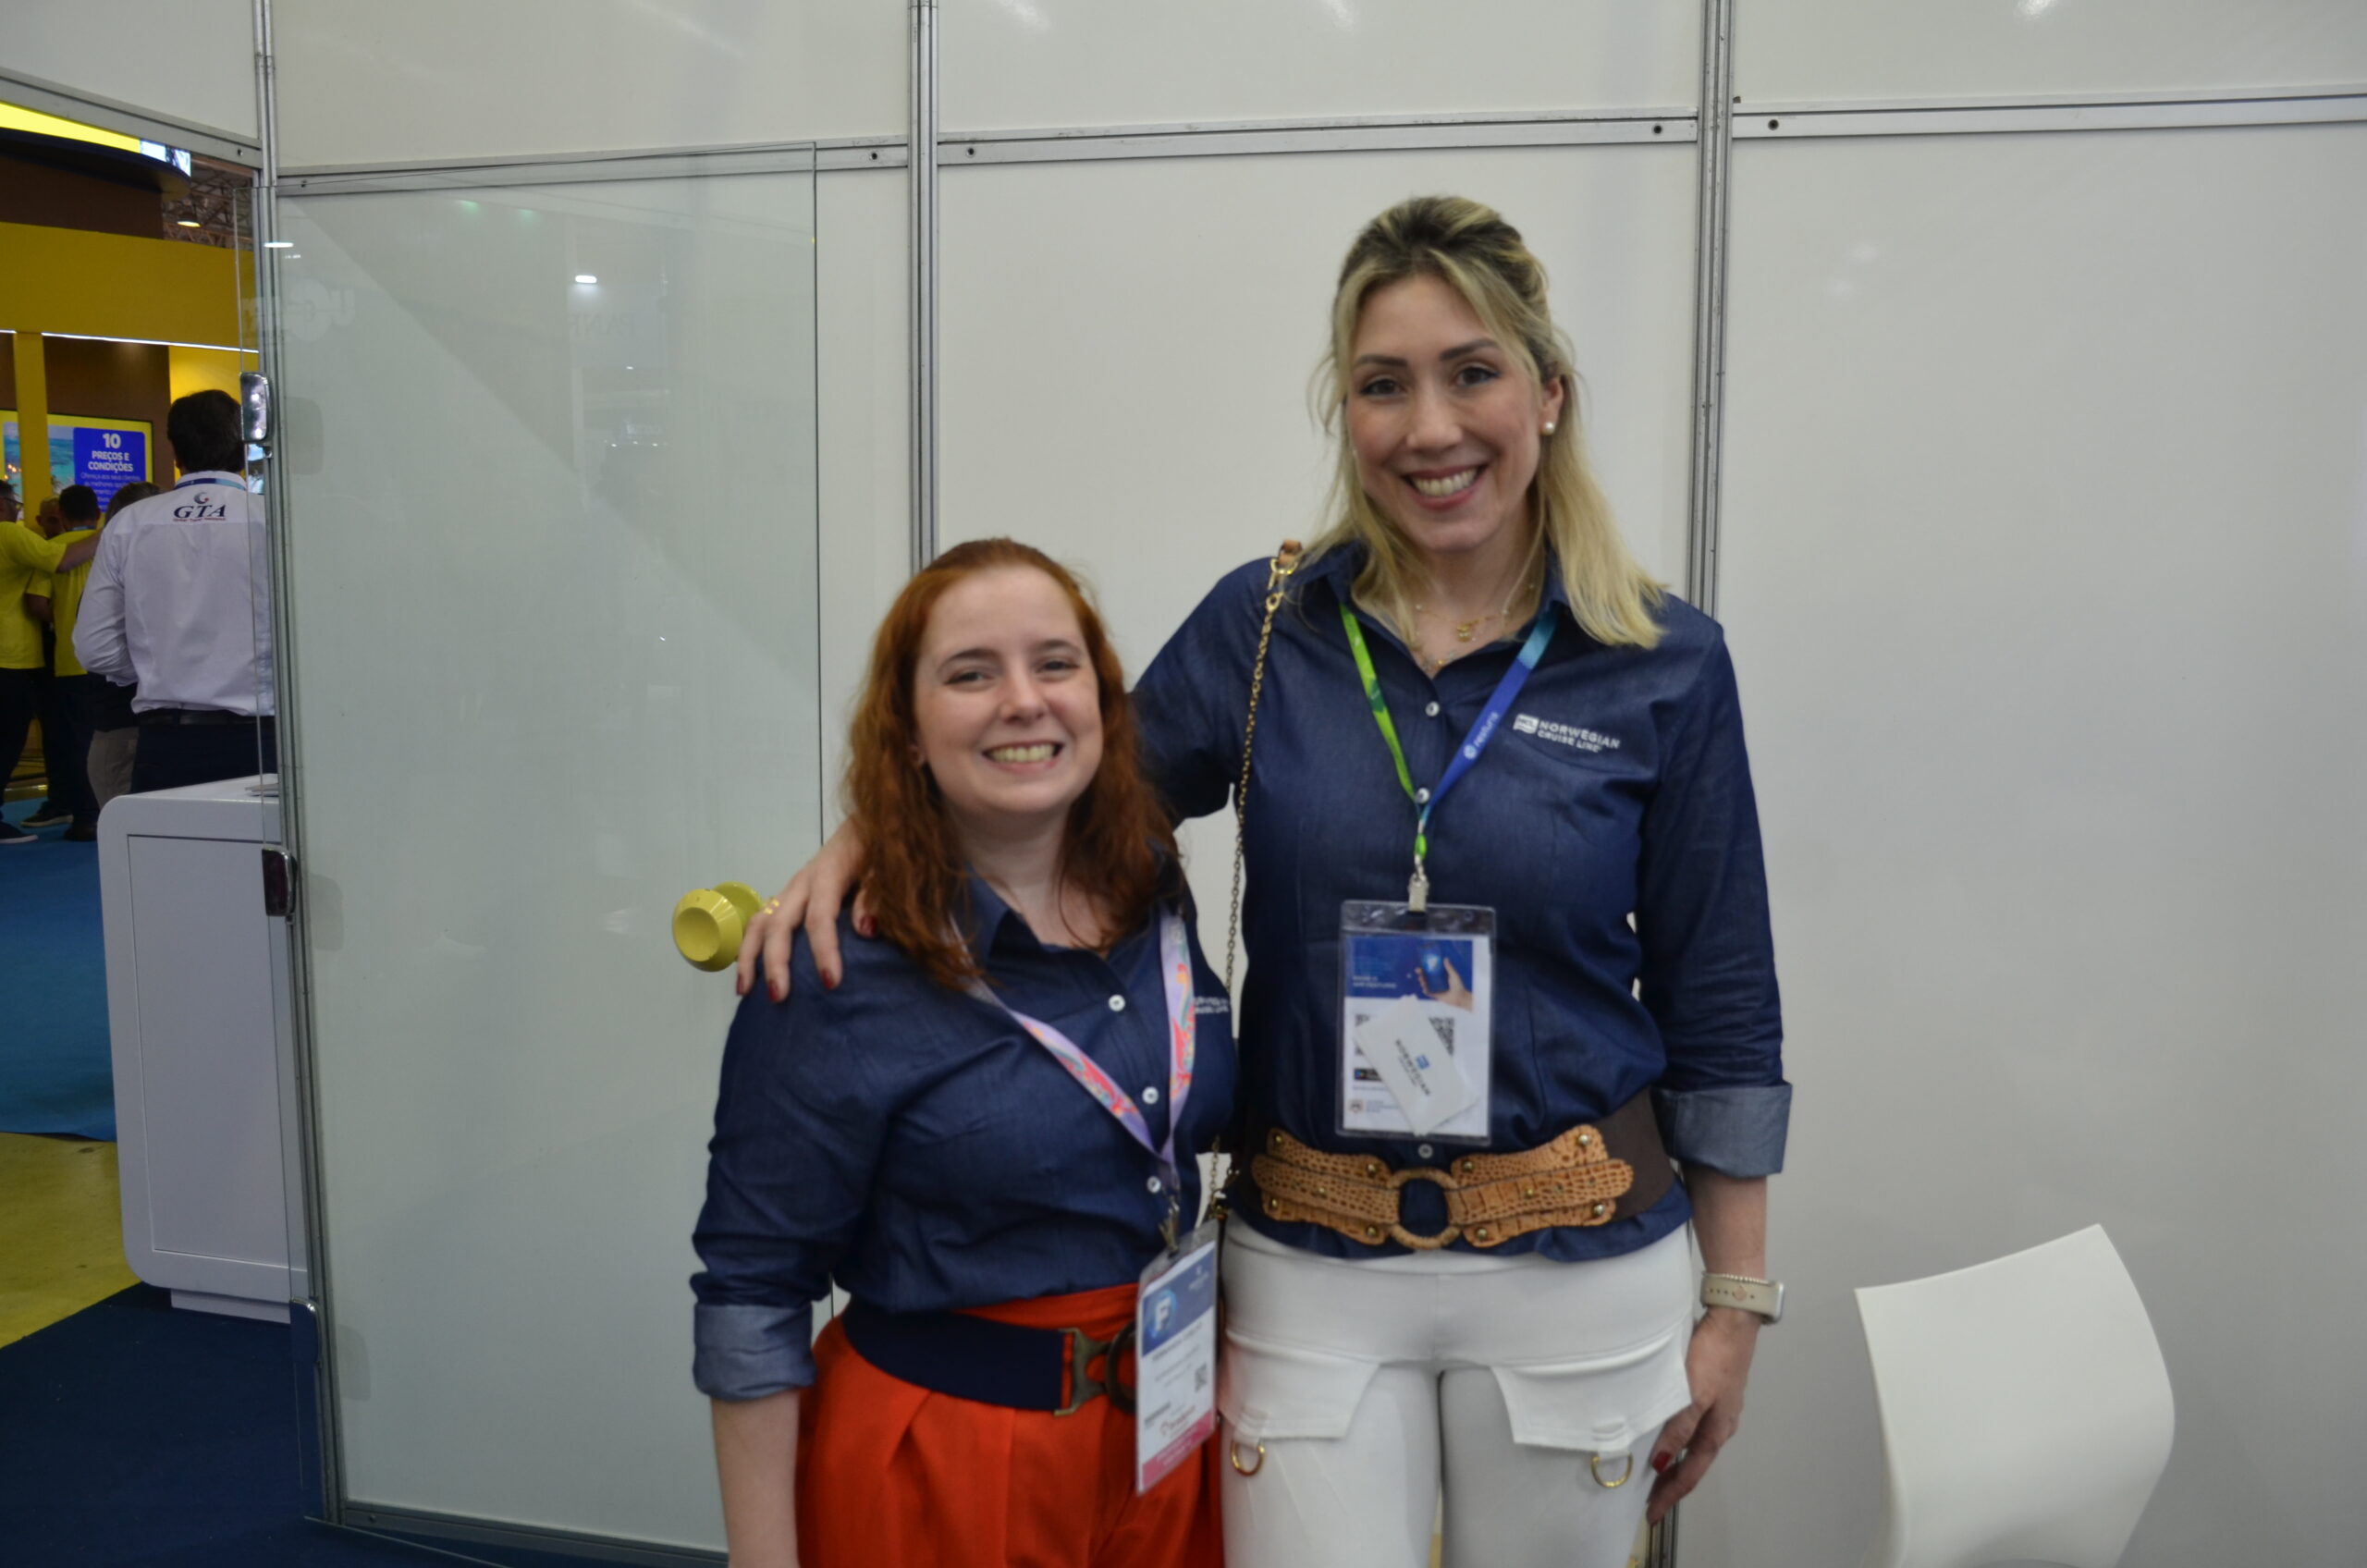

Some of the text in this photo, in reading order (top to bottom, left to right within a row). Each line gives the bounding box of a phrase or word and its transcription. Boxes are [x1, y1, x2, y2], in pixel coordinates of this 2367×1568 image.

[103, 433, 121, 449] 10
[92, 450, 130, 462] PREÇOS E
[88, 460, 134, 474] CONDIÇÕES
[174, 505, 227, 519] GTA
[1537, 730, 1575, 747] CRUISE
[1539, 720, 1620, 749] NORWEGIAN
